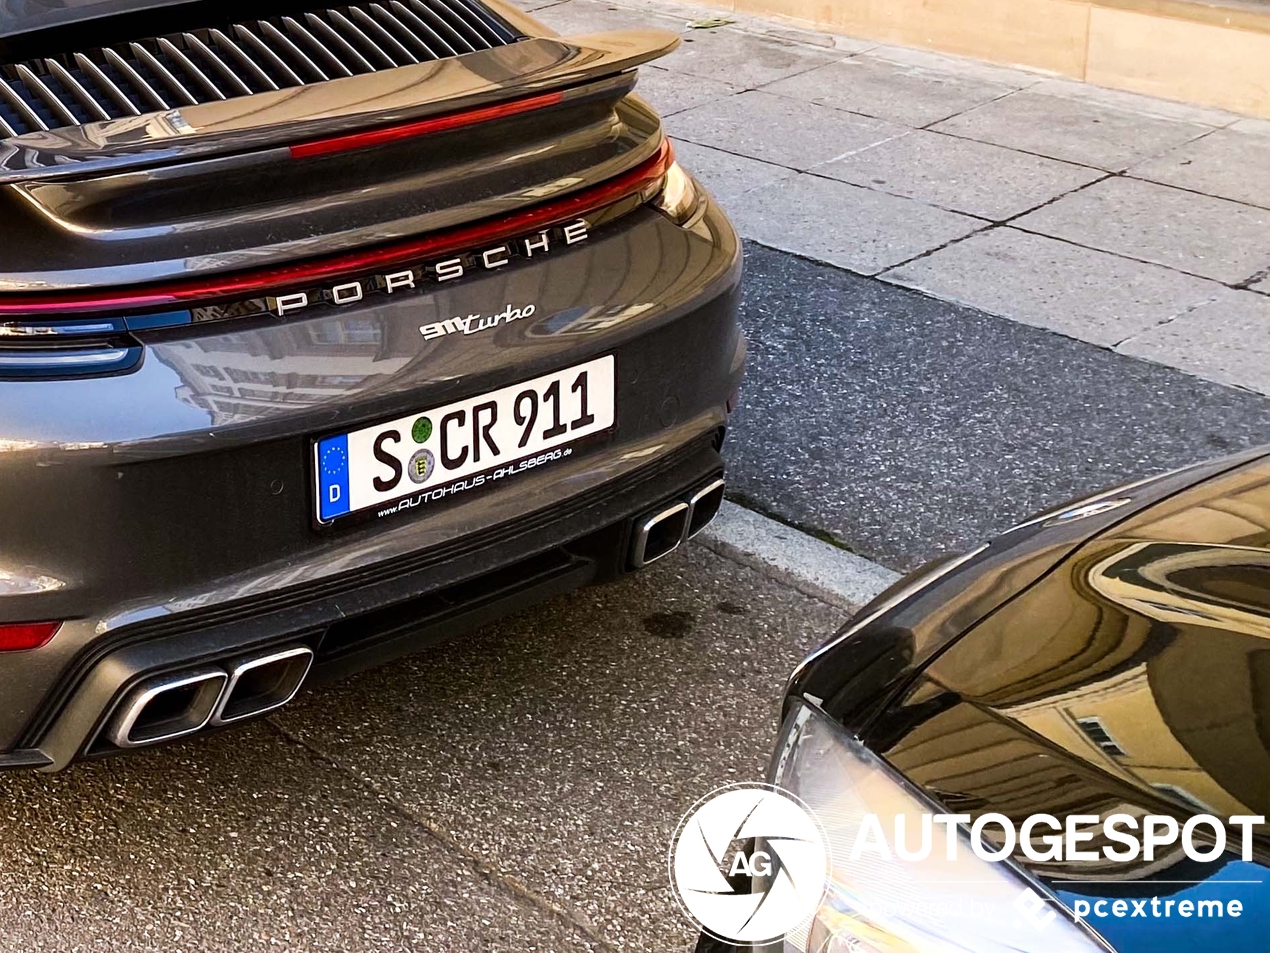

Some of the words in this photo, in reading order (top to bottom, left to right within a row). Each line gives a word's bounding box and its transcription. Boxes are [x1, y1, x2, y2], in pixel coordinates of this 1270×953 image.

[276, 219, 588, 316] PORSCHE
[419, 316, 464, 341] 911
[372, 429, 402, 492] S
[440, 400, 500, 470] CR
[514, 371, 594, 448] 911
[329, 484, 340, 502] D
